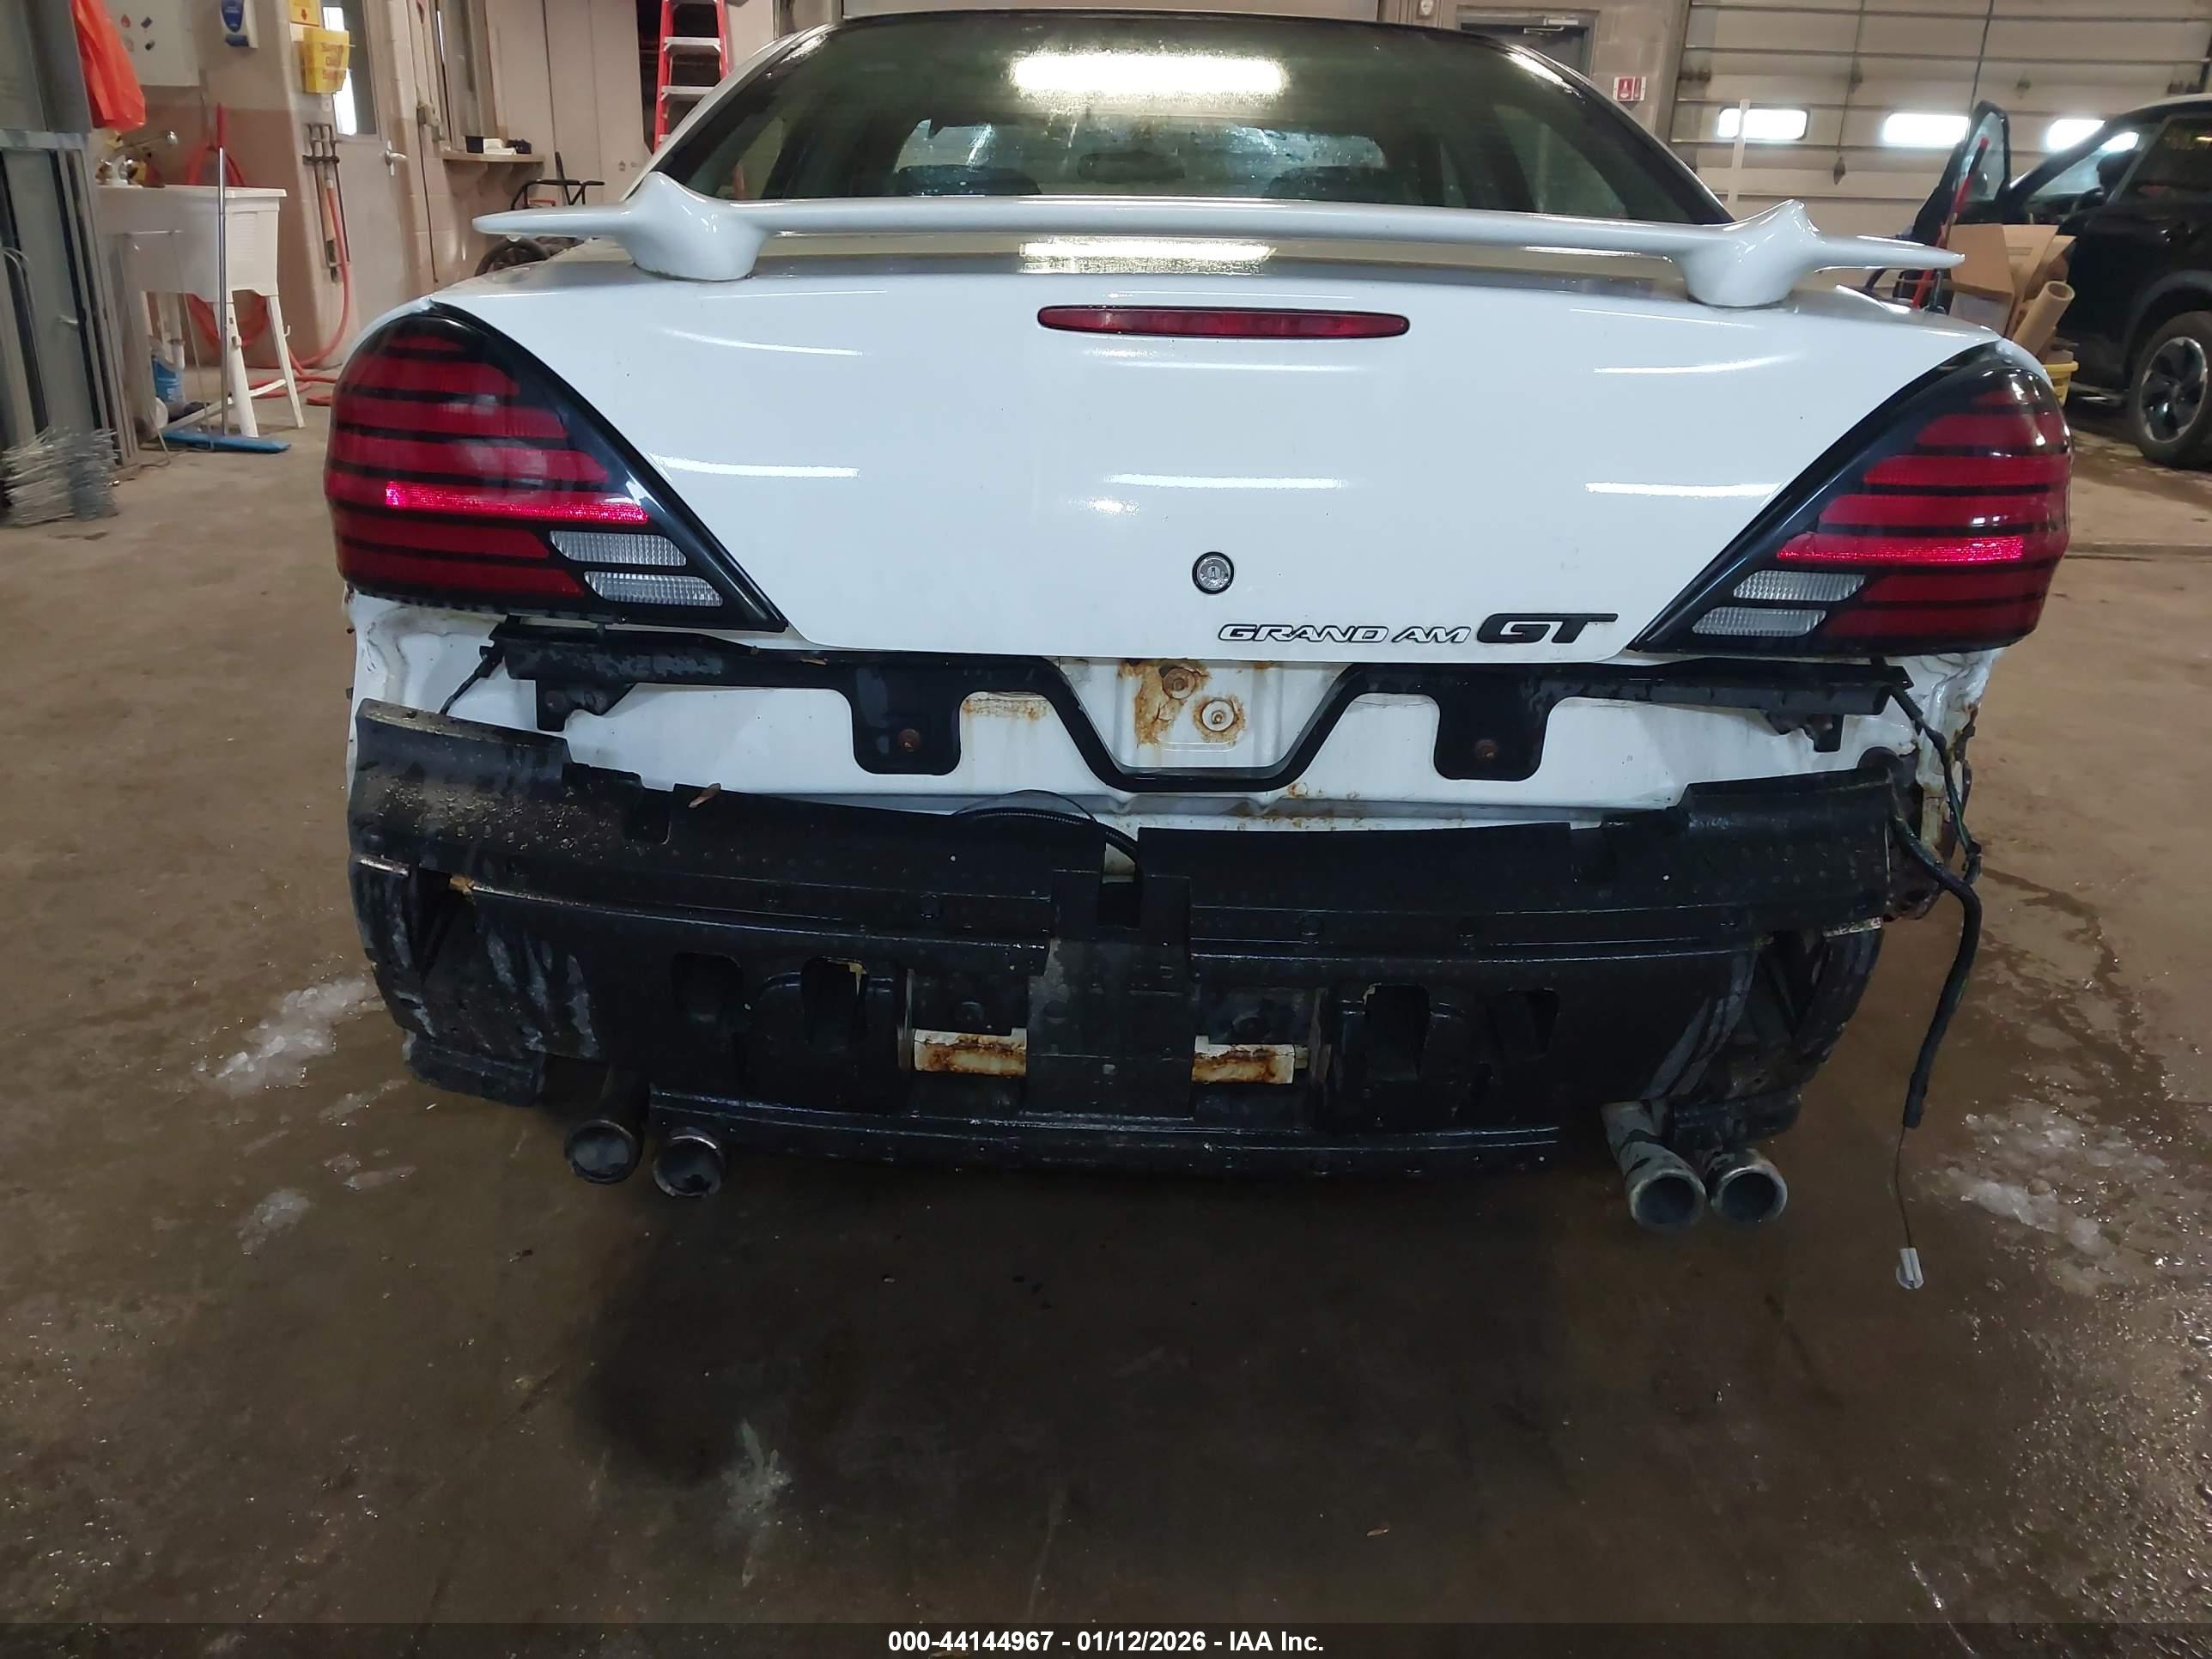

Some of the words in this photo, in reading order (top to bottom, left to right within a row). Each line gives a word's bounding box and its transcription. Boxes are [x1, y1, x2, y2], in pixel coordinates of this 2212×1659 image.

[1218, 623, 1389, 644] GRAND
[1390, 625, 1472, 644] AM
[1476, 612, 1619, 645] GT
